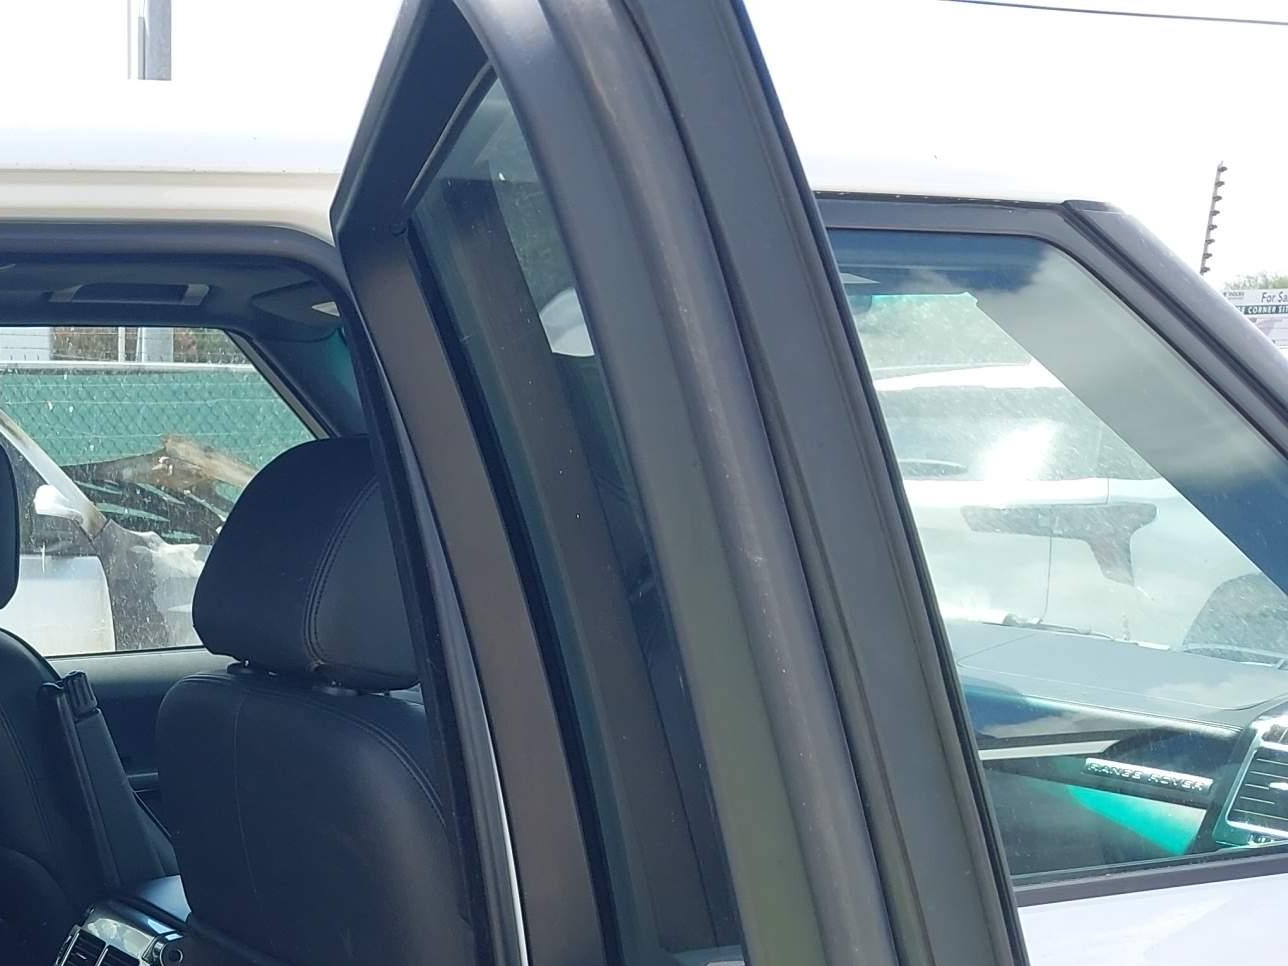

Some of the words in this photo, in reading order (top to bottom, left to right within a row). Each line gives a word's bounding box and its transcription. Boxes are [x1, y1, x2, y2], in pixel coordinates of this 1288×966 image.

[1261, 292, 1276, 303] For
[1247, 305, 1277, 314] CORNER
[1087, 763, 1143, 780] RANGE
[1148, 773, 1204, 792] ROVER
